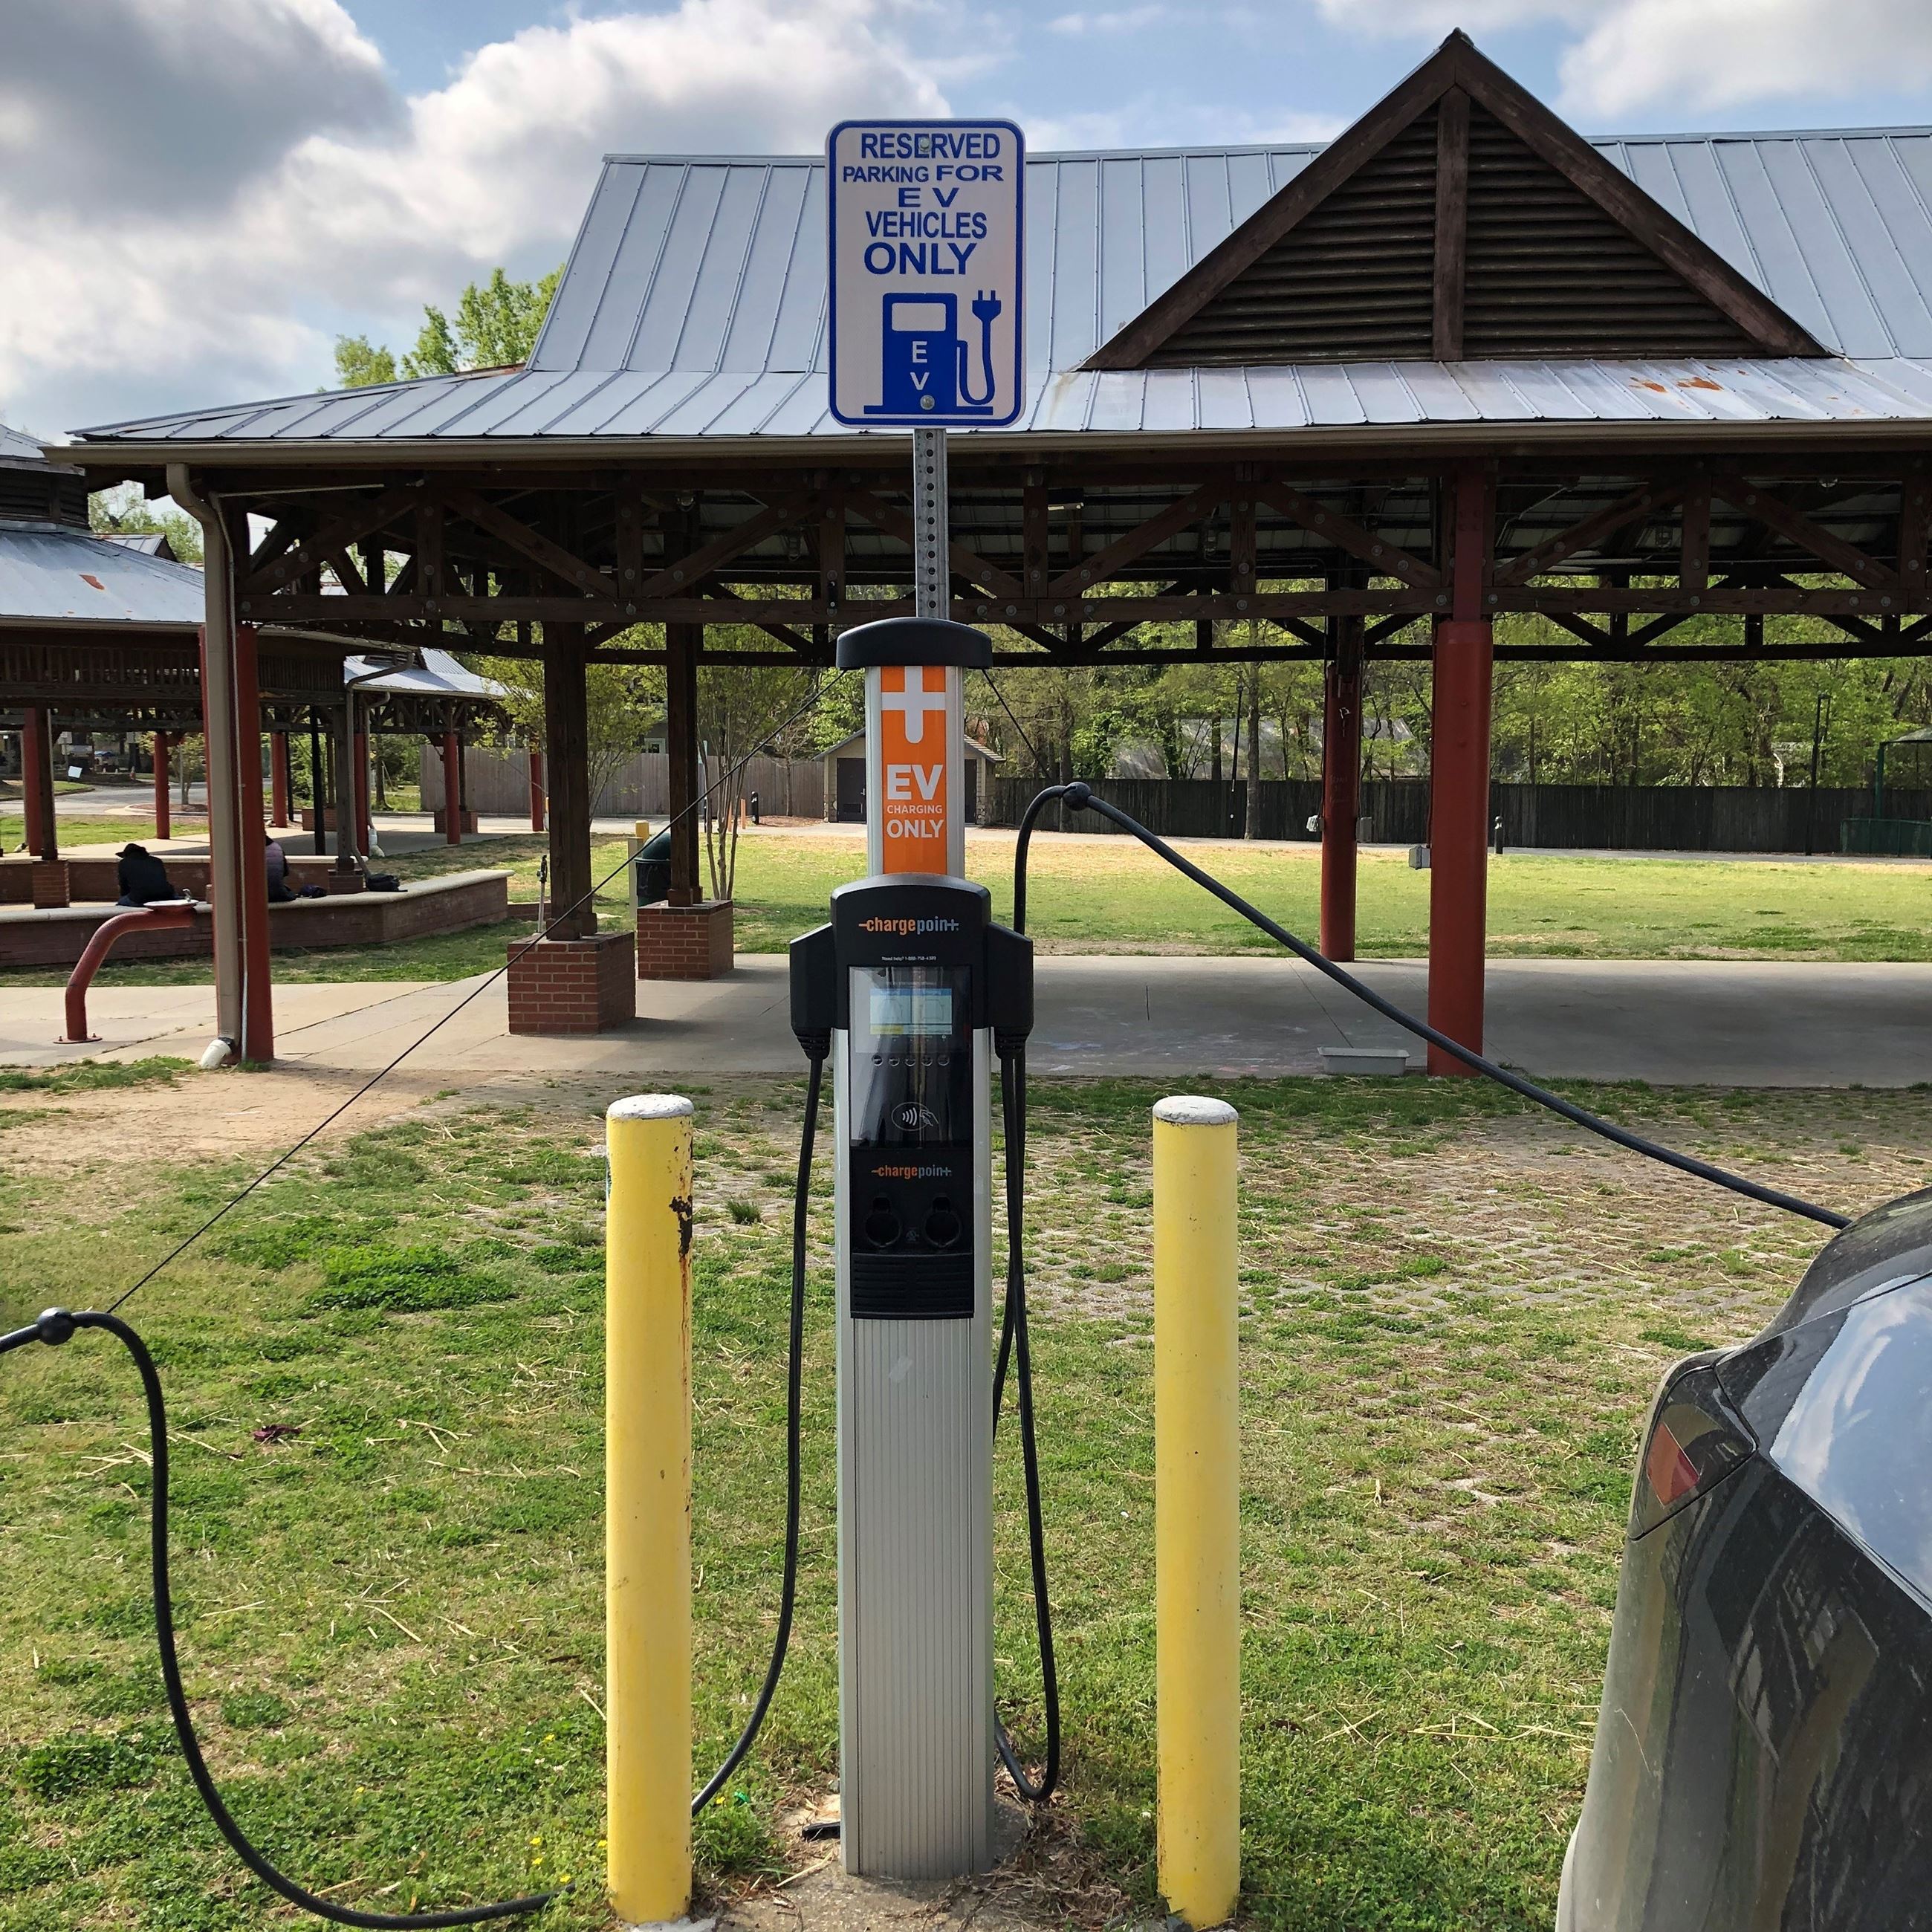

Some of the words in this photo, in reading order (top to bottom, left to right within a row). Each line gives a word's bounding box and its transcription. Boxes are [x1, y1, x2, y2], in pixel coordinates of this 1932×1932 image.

[861, 132, 1000, 159] RESERVED
[843, 166, 928, 183] PARKING
[936, 164, 1004, 182] FOR
[866, 211, 988, 239] VEHICLES
[864, 242, 977, 276] ONLY
[886, 764, 944, 800] EV
[886, 805, 943, 814] CHARGING
[886, 819, 944, 838] ONLY
